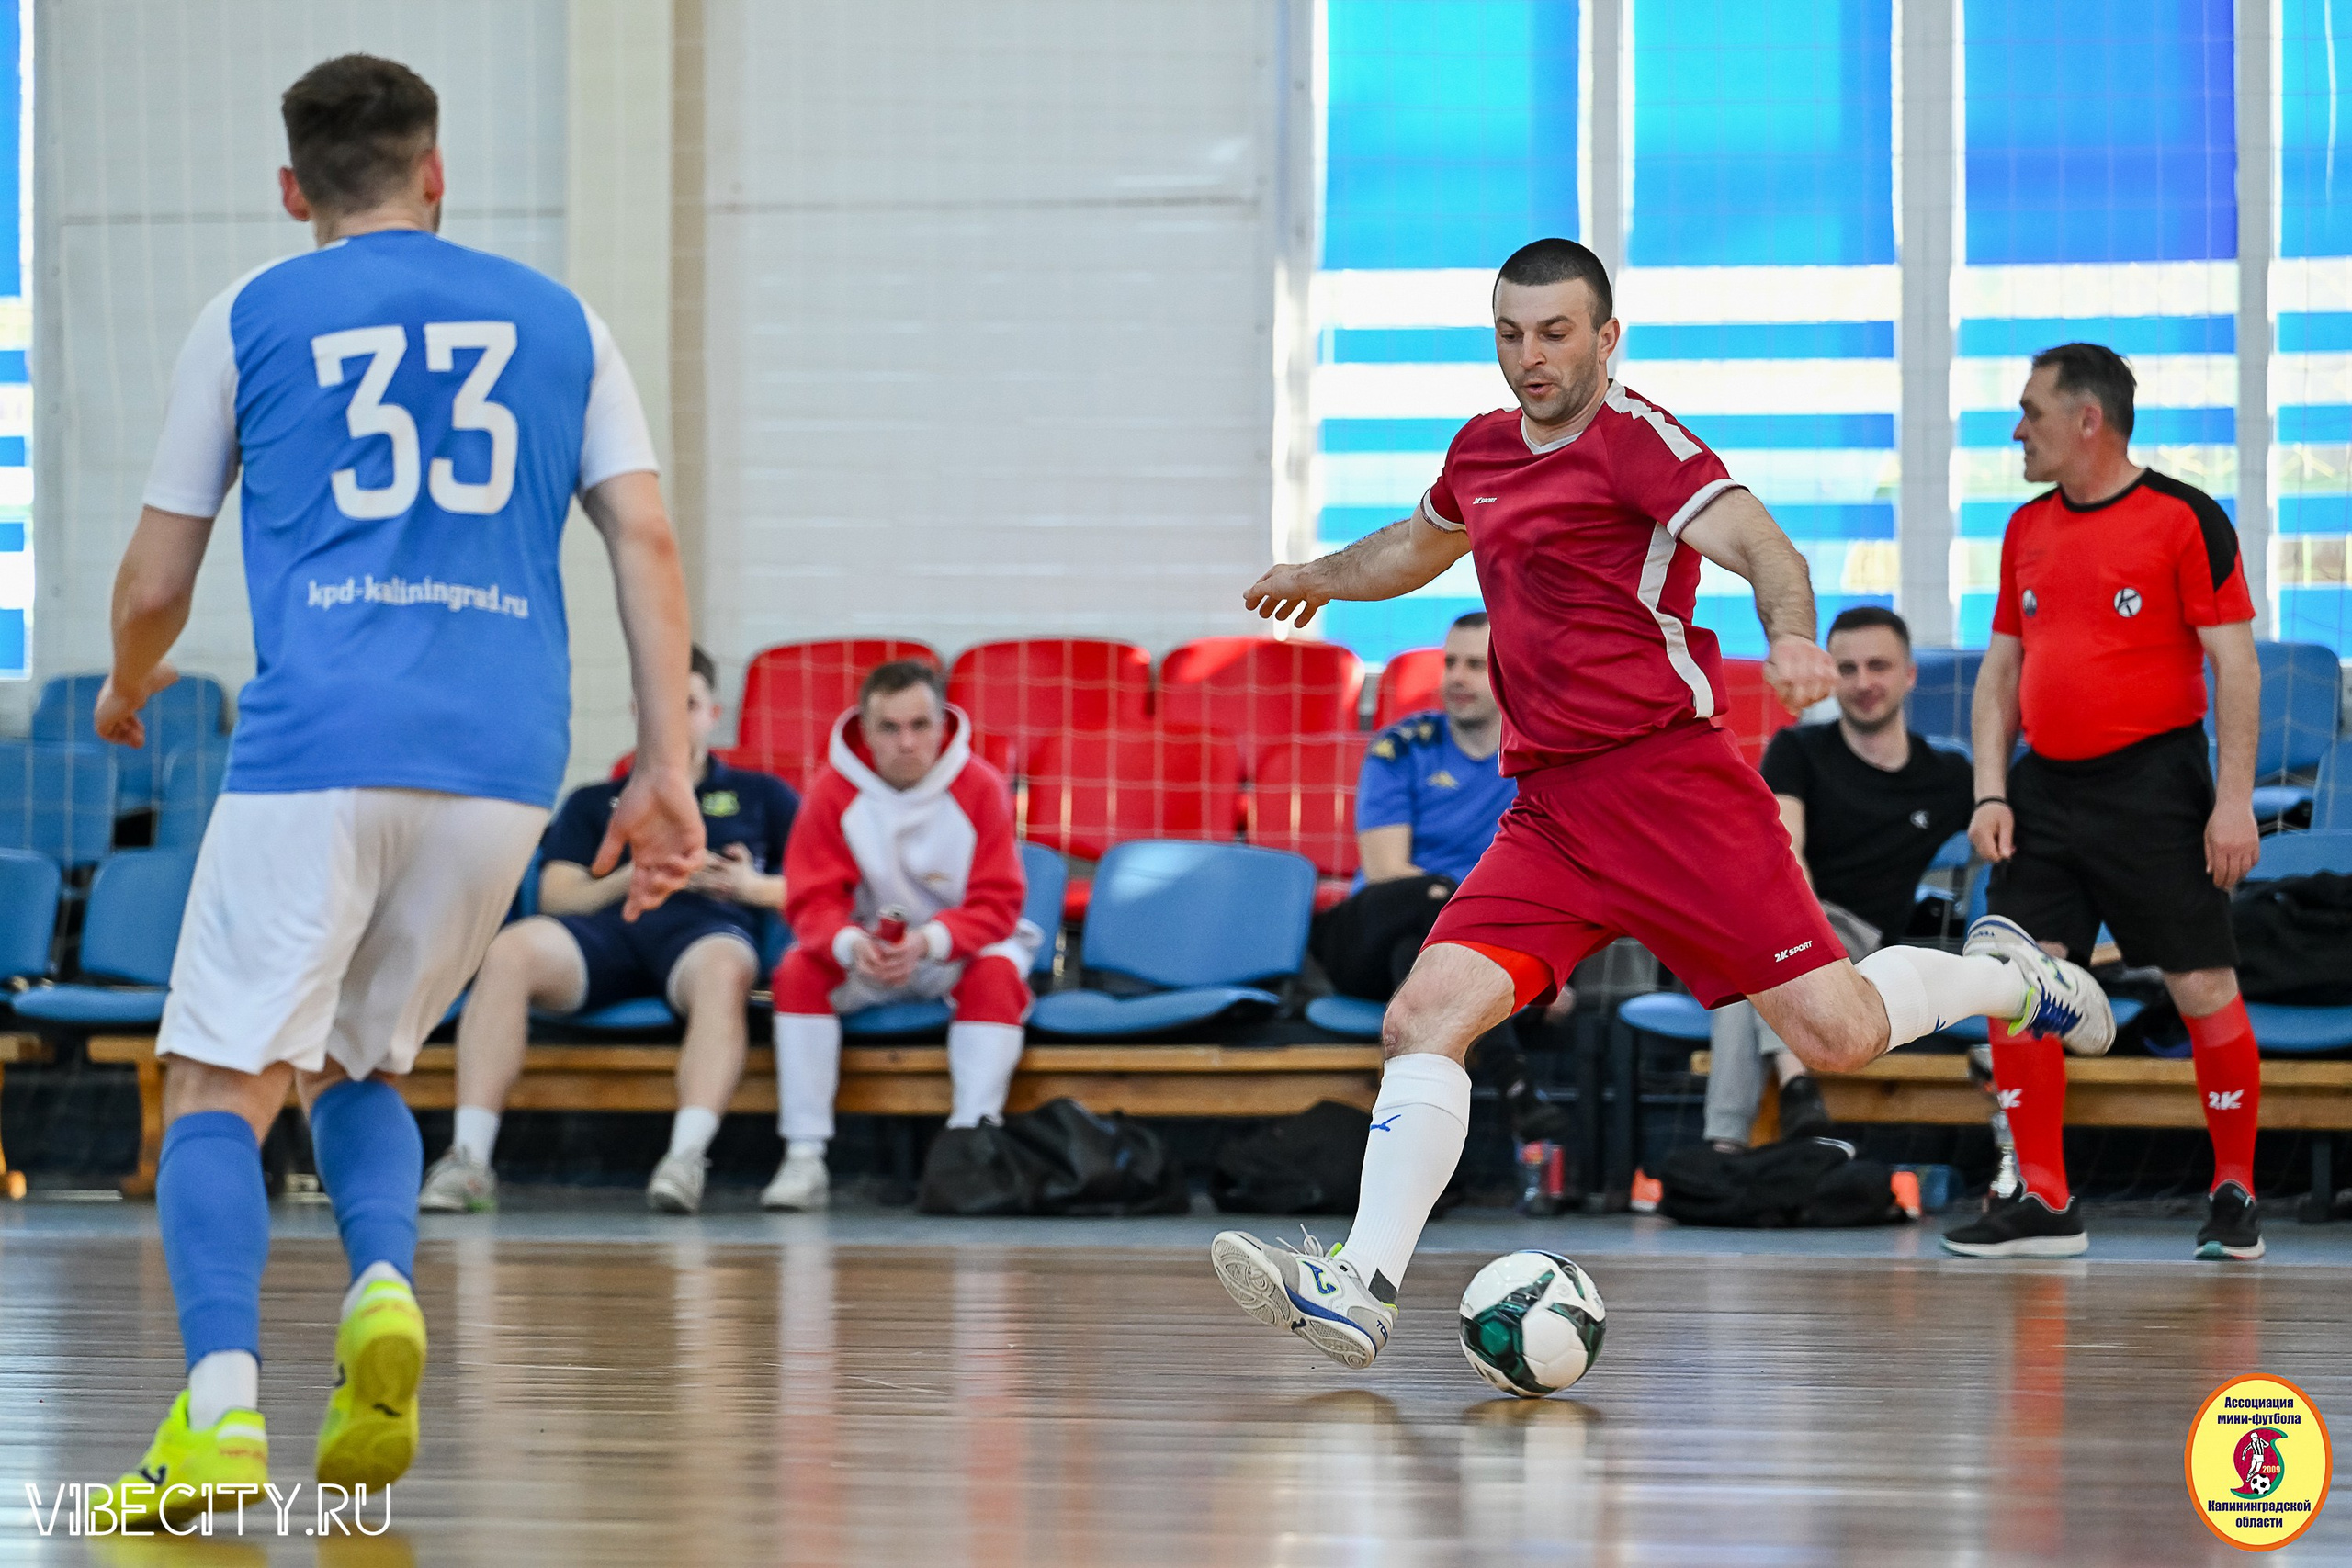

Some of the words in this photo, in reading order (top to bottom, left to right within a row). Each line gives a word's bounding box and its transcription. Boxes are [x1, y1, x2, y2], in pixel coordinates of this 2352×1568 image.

[311, 321, 519, 521] 33
[307, 574, 529, 619] kpd-kaliningrad.ru
[1774, 949, 1789, 963] 2K
[1788, 940, 1813, 956] SPORT
[2208, 1089, 2245, 1111] 2K
